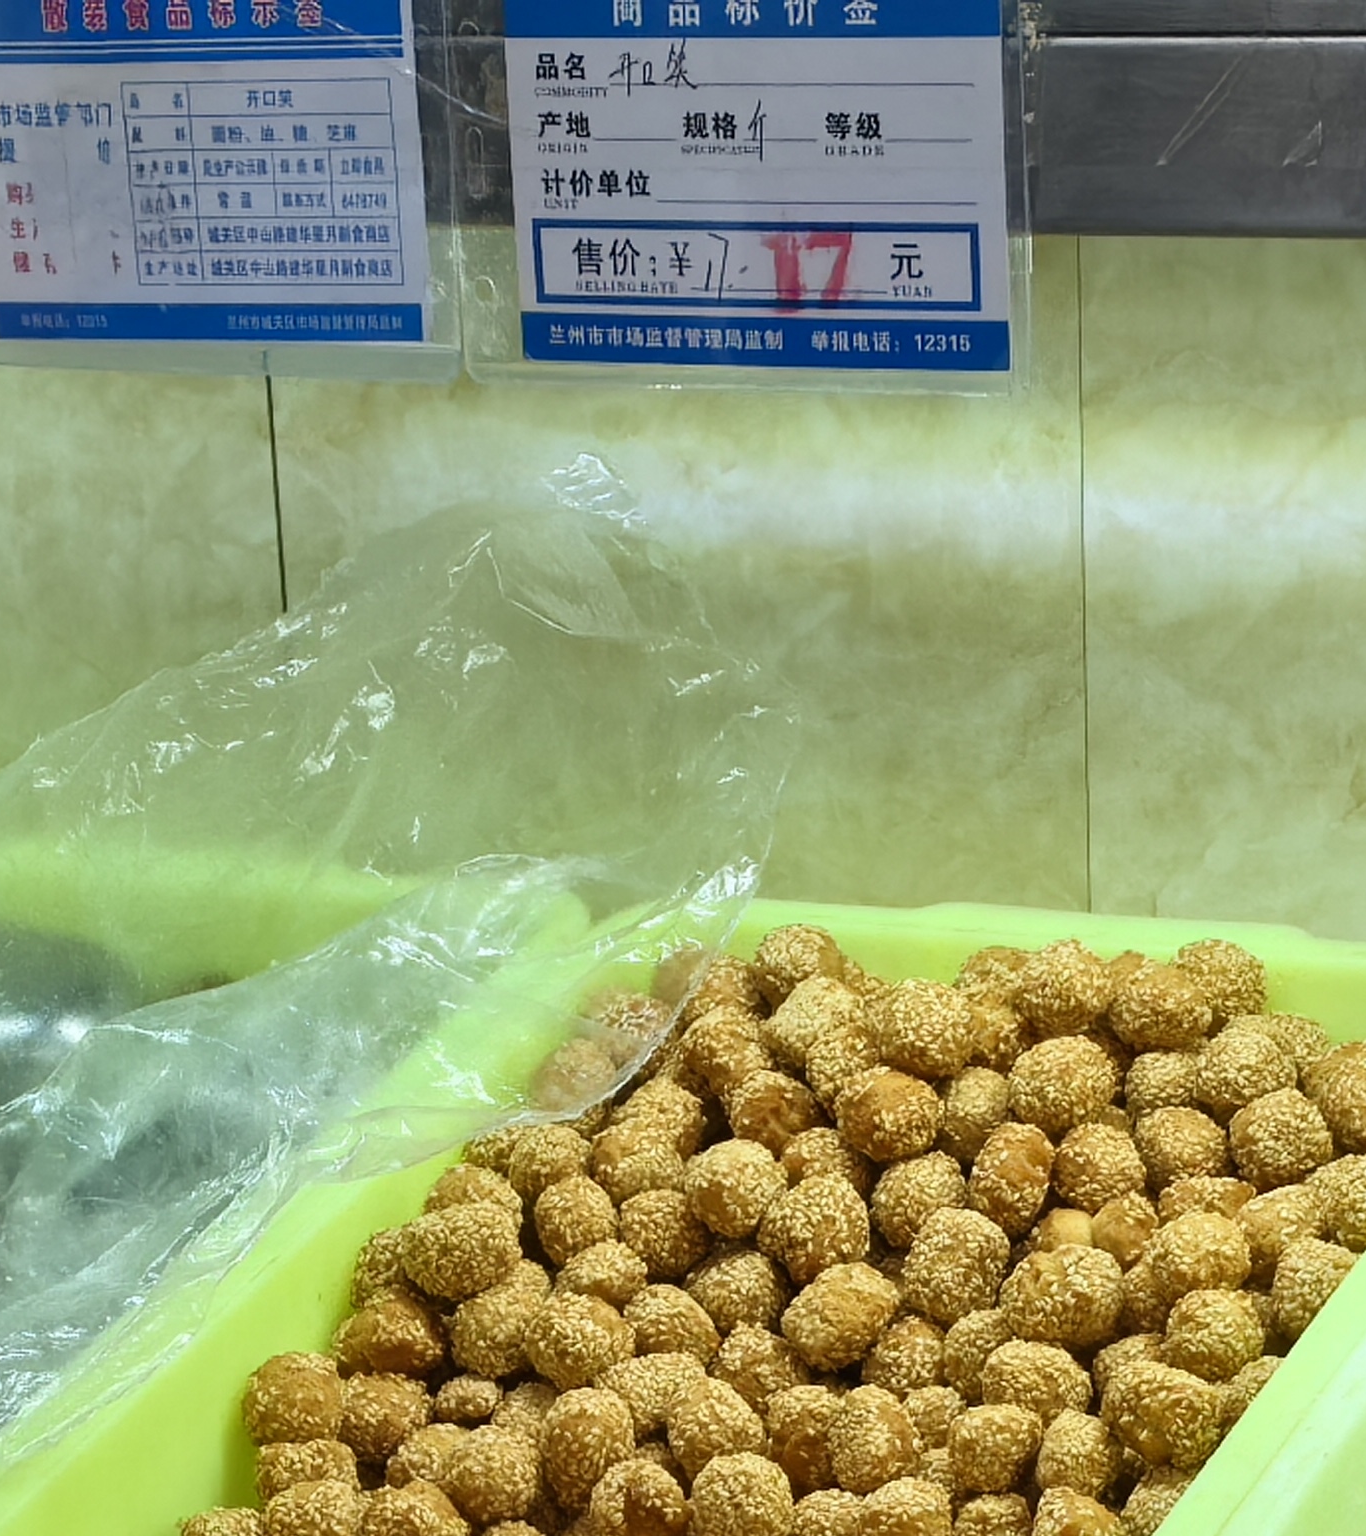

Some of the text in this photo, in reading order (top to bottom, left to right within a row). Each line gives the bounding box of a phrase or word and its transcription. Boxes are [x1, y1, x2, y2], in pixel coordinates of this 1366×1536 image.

[536, 52, 586, 80] 品名
[247, 90, 294, 108] 开口笑
[538, 111, 591, 139] 产地
[683, 111, 737, 140] 规格
[825, 112, 882, 140] 等级
[541, 168, 651, 198] 计价单位
[759, 230, 852, 313] 17
[891, 243, 924, 280] 元
[549, 325, 783, 352] 兰州市市场监督管理局监制
[914, 333, 971, 353] 12315
